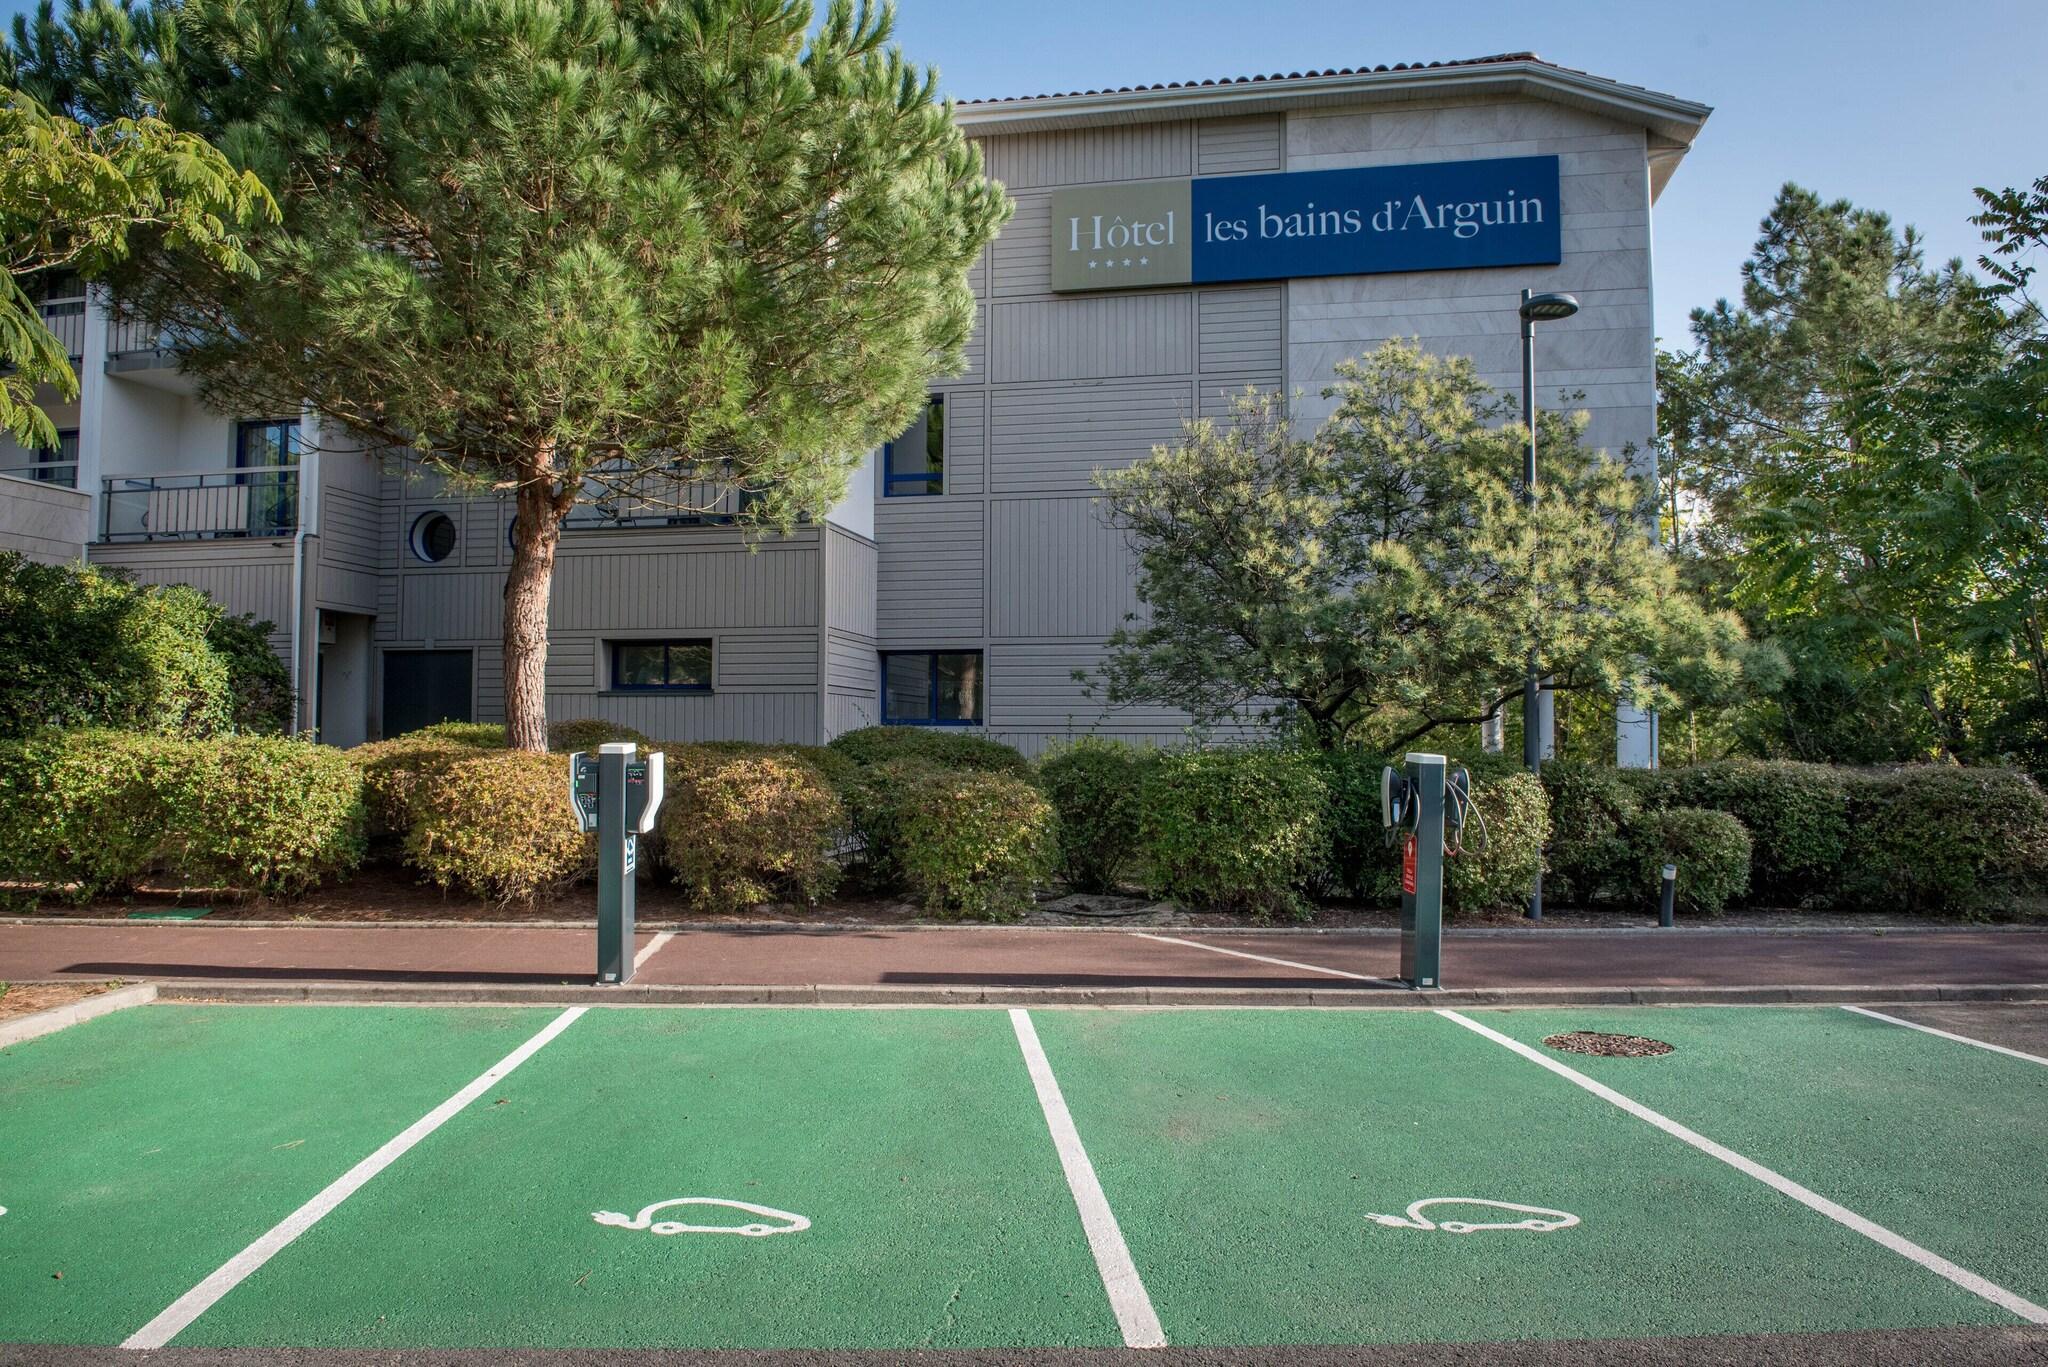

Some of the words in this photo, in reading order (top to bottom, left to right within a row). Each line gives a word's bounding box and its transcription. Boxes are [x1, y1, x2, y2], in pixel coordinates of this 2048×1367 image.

[1069, 211, 1175, 251] Hôtel
[1205, 213, 1248, 243] les
[1258, 203, 1361, 239] bains
[1372, 190, 1544, 239] d'Arguin
